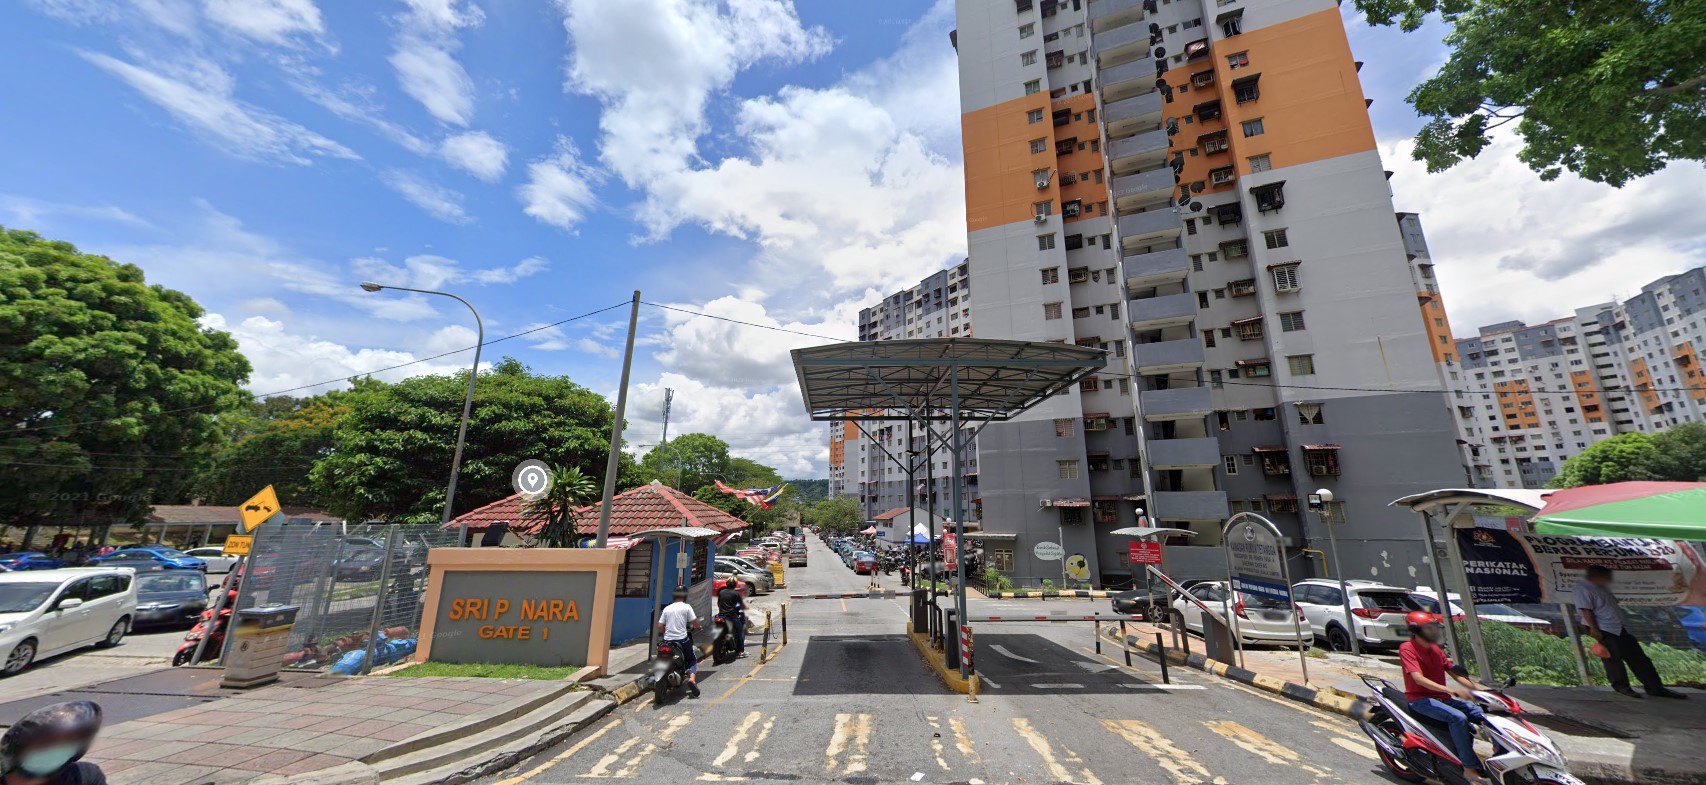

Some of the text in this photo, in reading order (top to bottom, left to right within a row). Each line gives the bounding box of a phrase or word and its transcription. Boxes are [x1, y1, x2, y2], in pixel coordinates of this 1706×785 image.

[1531, 544, 1582, 556] BERAS
[1465, 567, 1528, 577] NASIONAL
[448, 598, 488, 621] SRI
[520, 599, 580, 622] NARA
[478, 625, 531, 640] GATE
